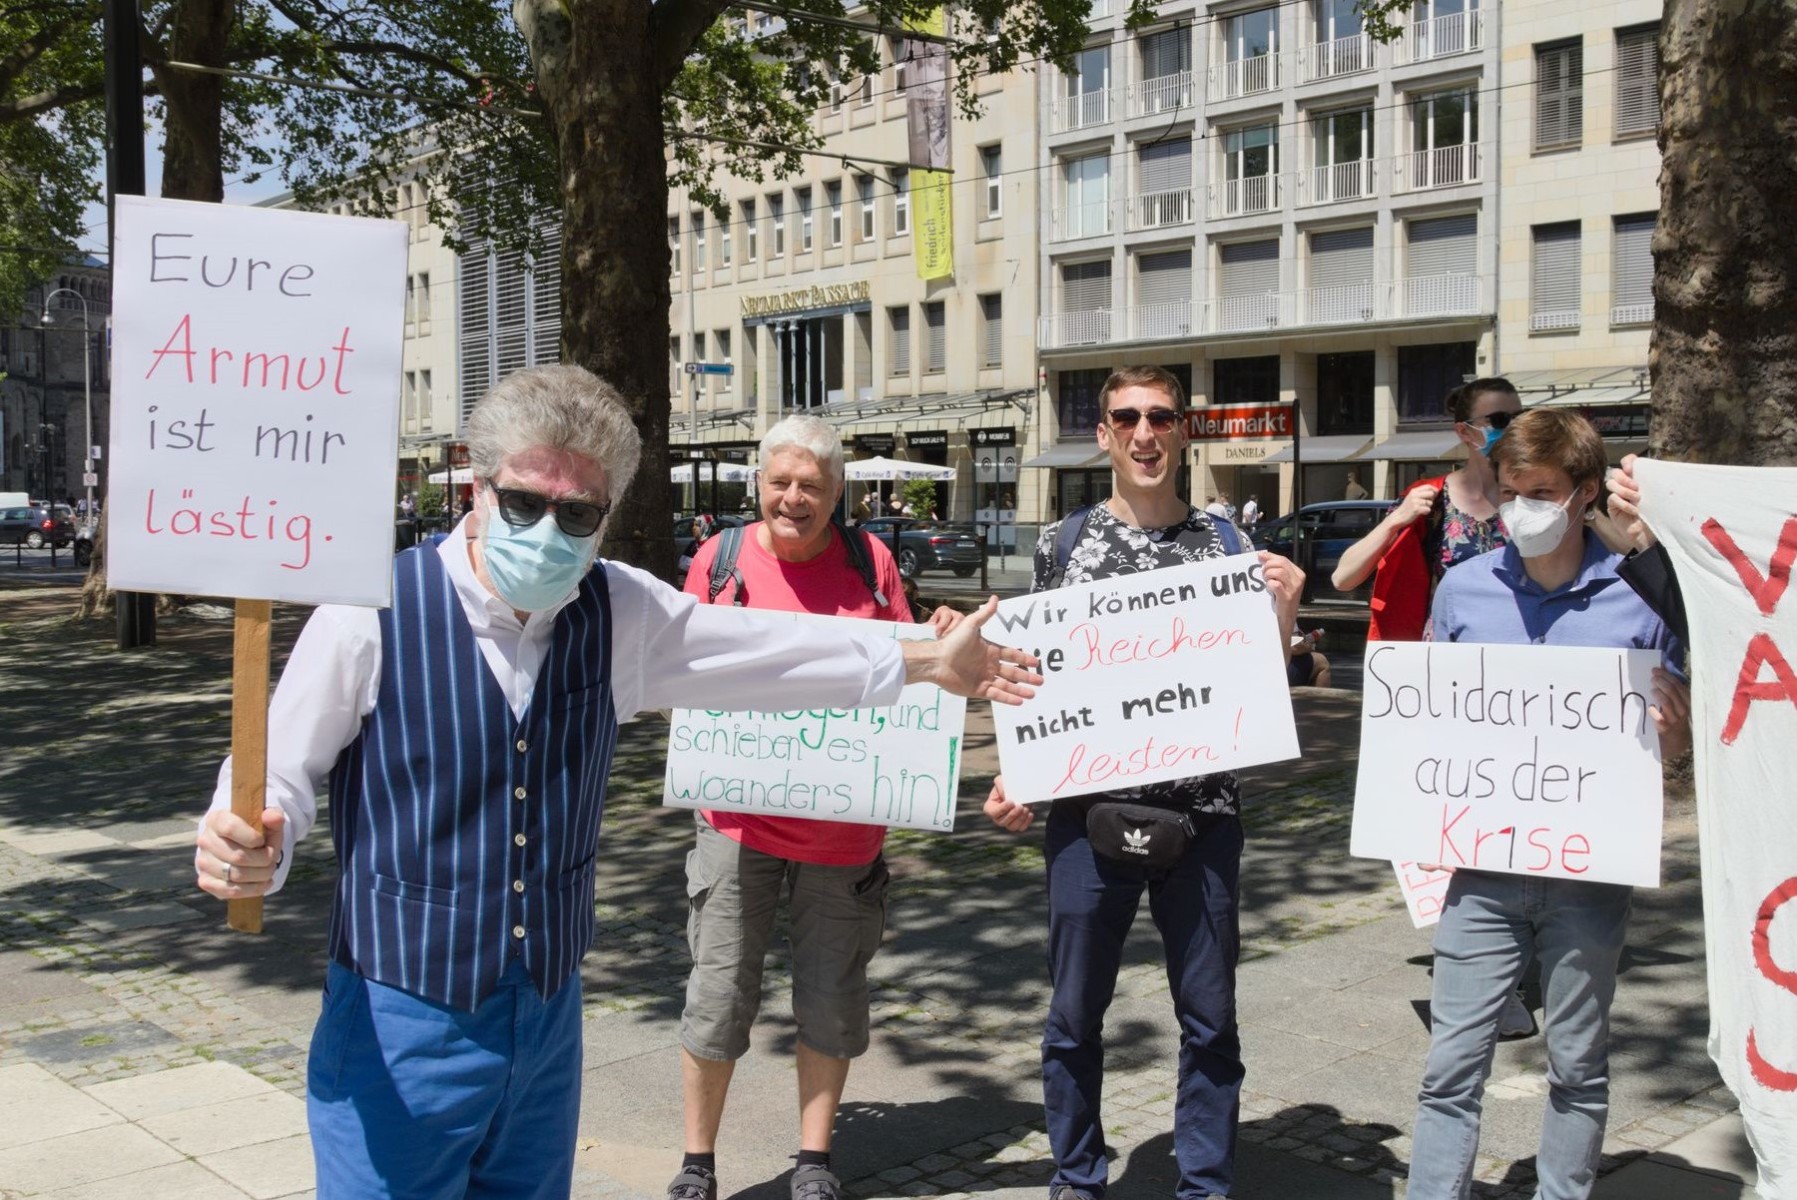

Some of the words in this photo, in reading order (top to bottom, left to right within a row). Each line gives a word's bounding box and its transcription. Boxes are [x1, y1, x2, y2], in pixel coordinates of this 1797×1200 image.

[149, 232, 314, 298] Eure
[144, 313, 356, 396] Armut
[147, 405, 215, 452] ist
[254, 413, 346, 465] mir
[1191, 411, 1287, 436] Neumarkt
[1225, 447, 1266, 459] DANIELS
[145, 488, 334, 570] lästig.
[997, 599, 1068, 634] Wir
[1089, 580, 1196, 619] können
[1211, 563, 1266, 598] uns
[1069, 616, 1252, 671] Reichen
[1015, 706, 1095, 745] nicht
[1122, 682, 1213, 721] mehr
[1368, 645, 1648, 735] Solidarisch
[673, 719, 803, 762] schieben
[827, 736, 868, 763] es
[1415, 757, 1496, 799] aus
[1512, 735, 1597, 803] der
[871, 736, 960, 828] hin!
[1122, 845, 1149, 856] adidas
